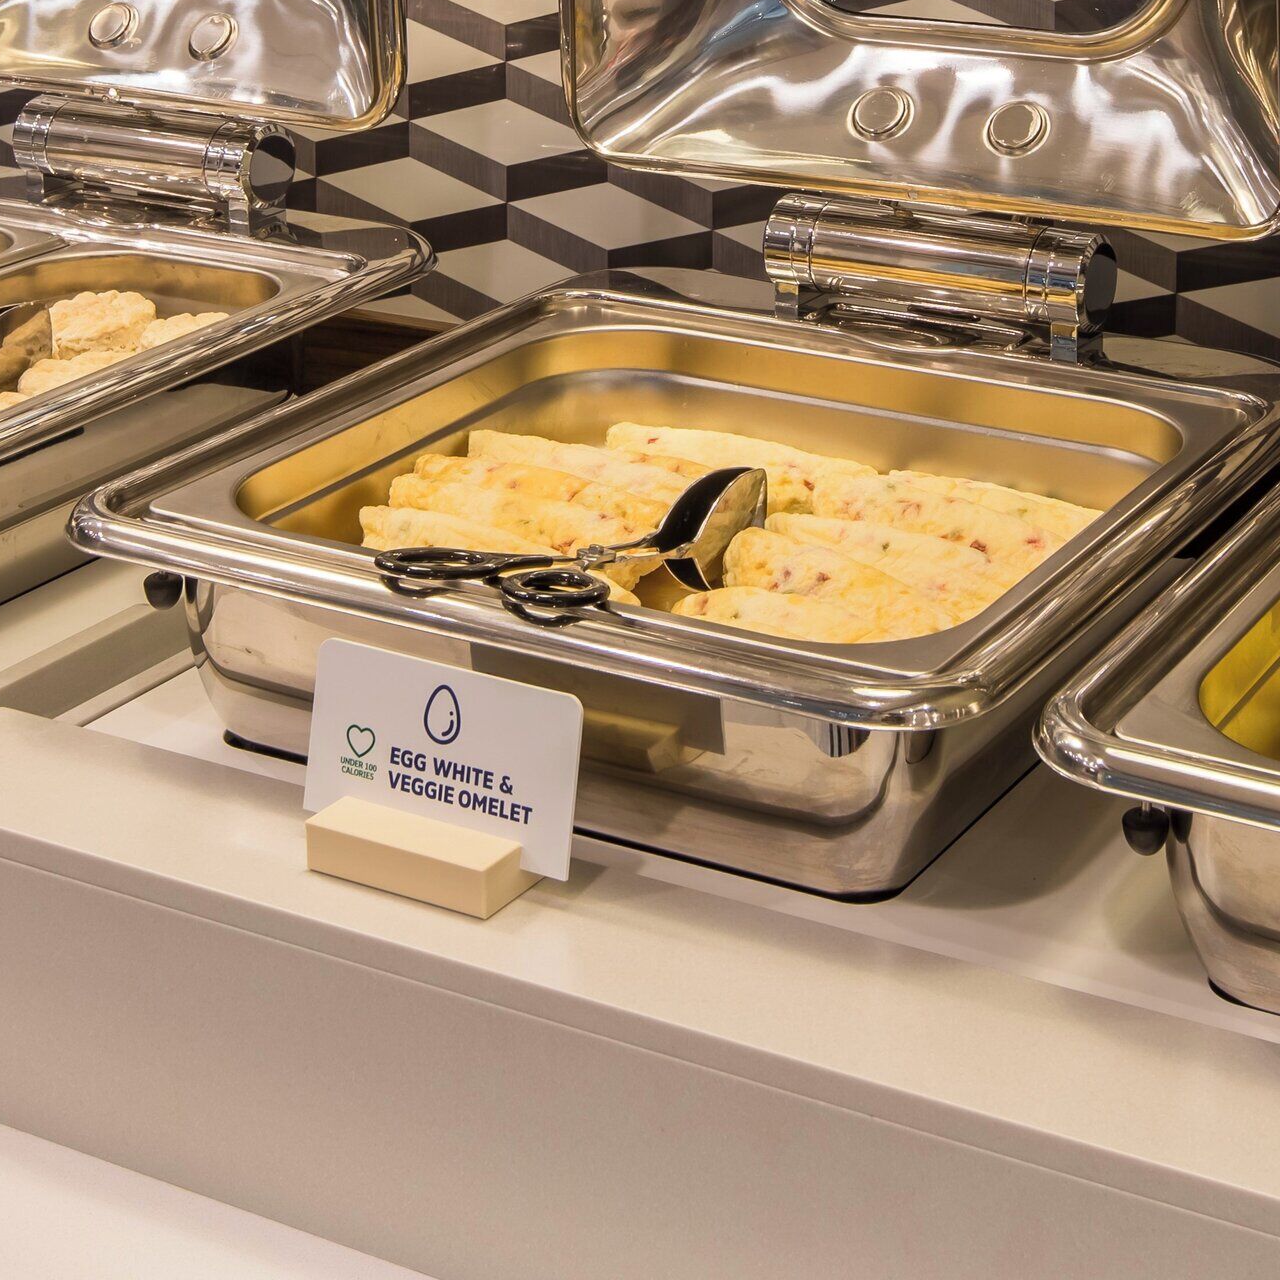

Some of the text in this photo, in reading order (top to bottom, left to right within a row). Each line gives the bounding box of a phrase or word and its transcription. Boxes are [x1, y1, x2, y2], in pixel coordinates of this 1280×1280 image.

[340, 756, 378, 773] UNDER 100
[341, 765, 375, 781] CALORIES
[389, 746, 514, 796] EGG WHITE &
[388, 770, 533, 825] VEGGIE OMELET
